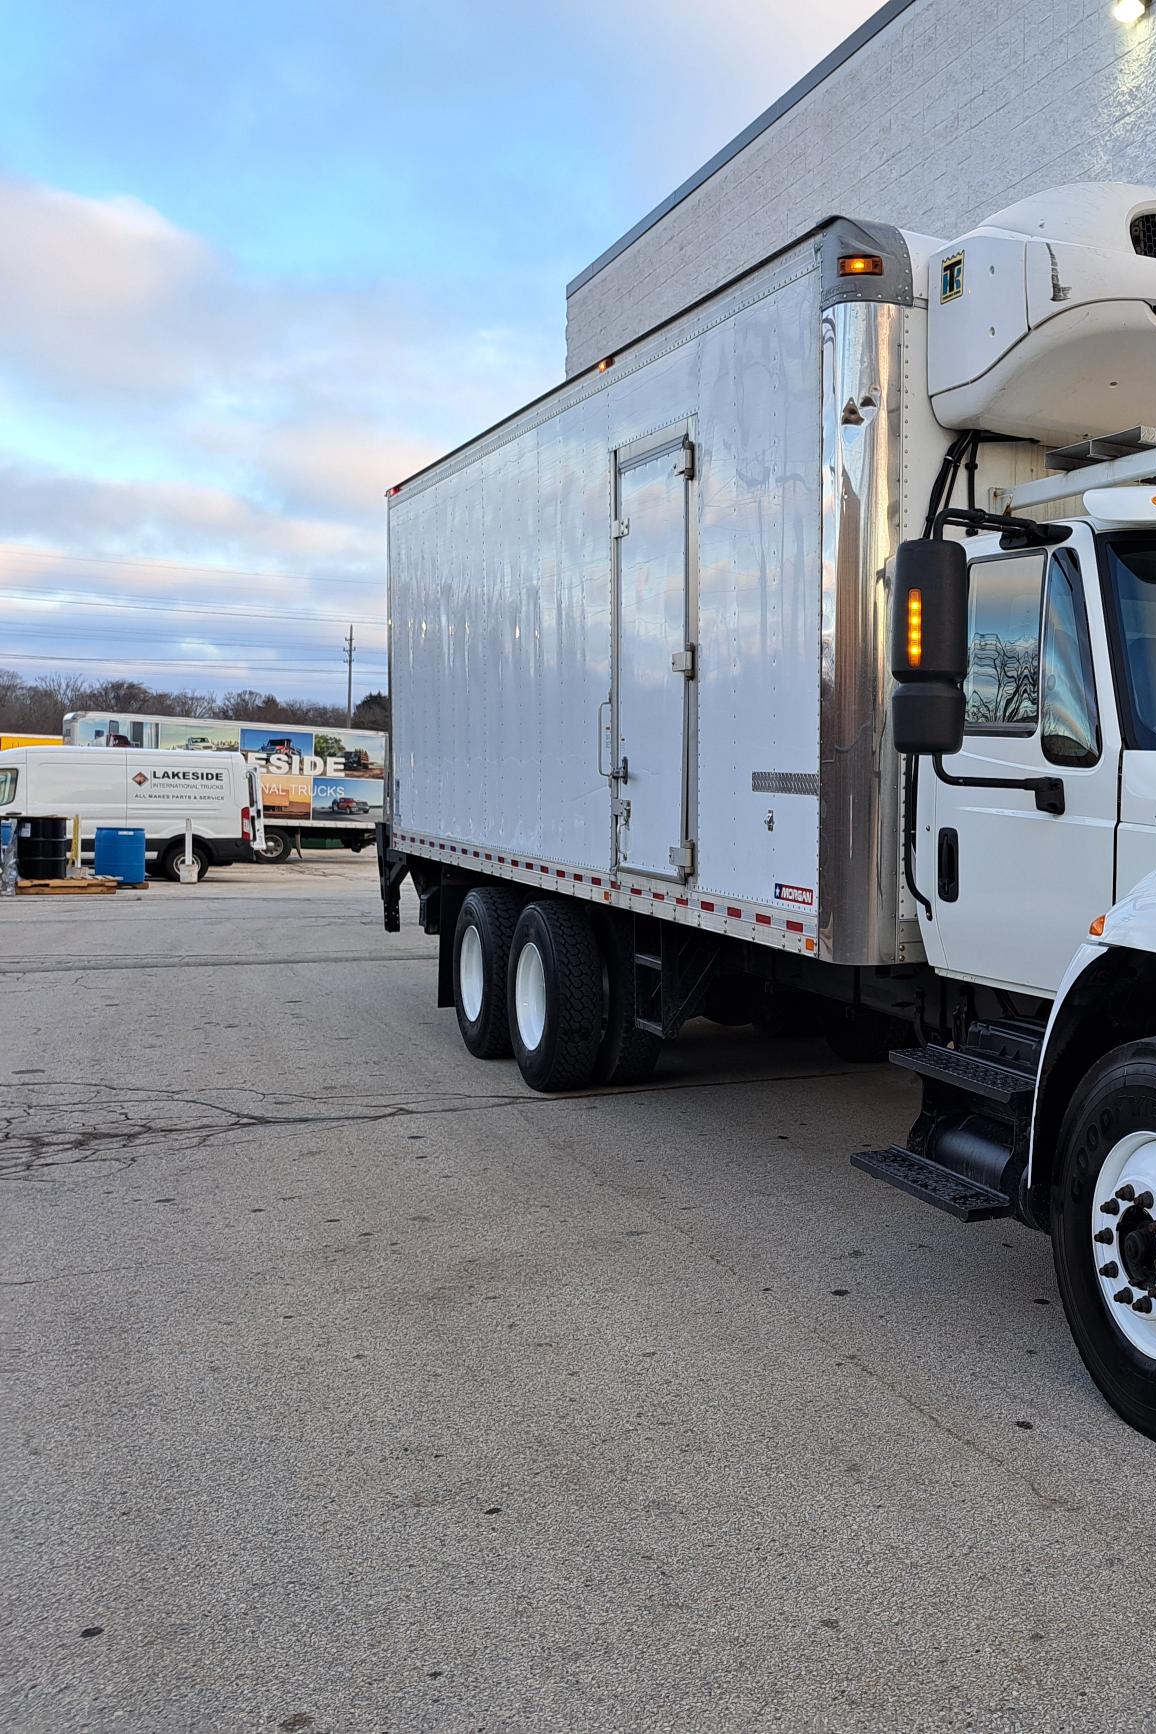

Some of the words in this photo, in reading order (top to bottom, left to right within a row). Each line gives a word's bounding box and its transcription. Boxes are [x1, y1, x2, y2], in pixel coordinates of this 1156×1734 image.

[153, 770, 224, 781] LAKESIDE
[153, 782, 199, 790] INTERNATIONAL
[289, 784, 345, 797] TRUCKS
[780, 887, 812, 903] MORGAN
